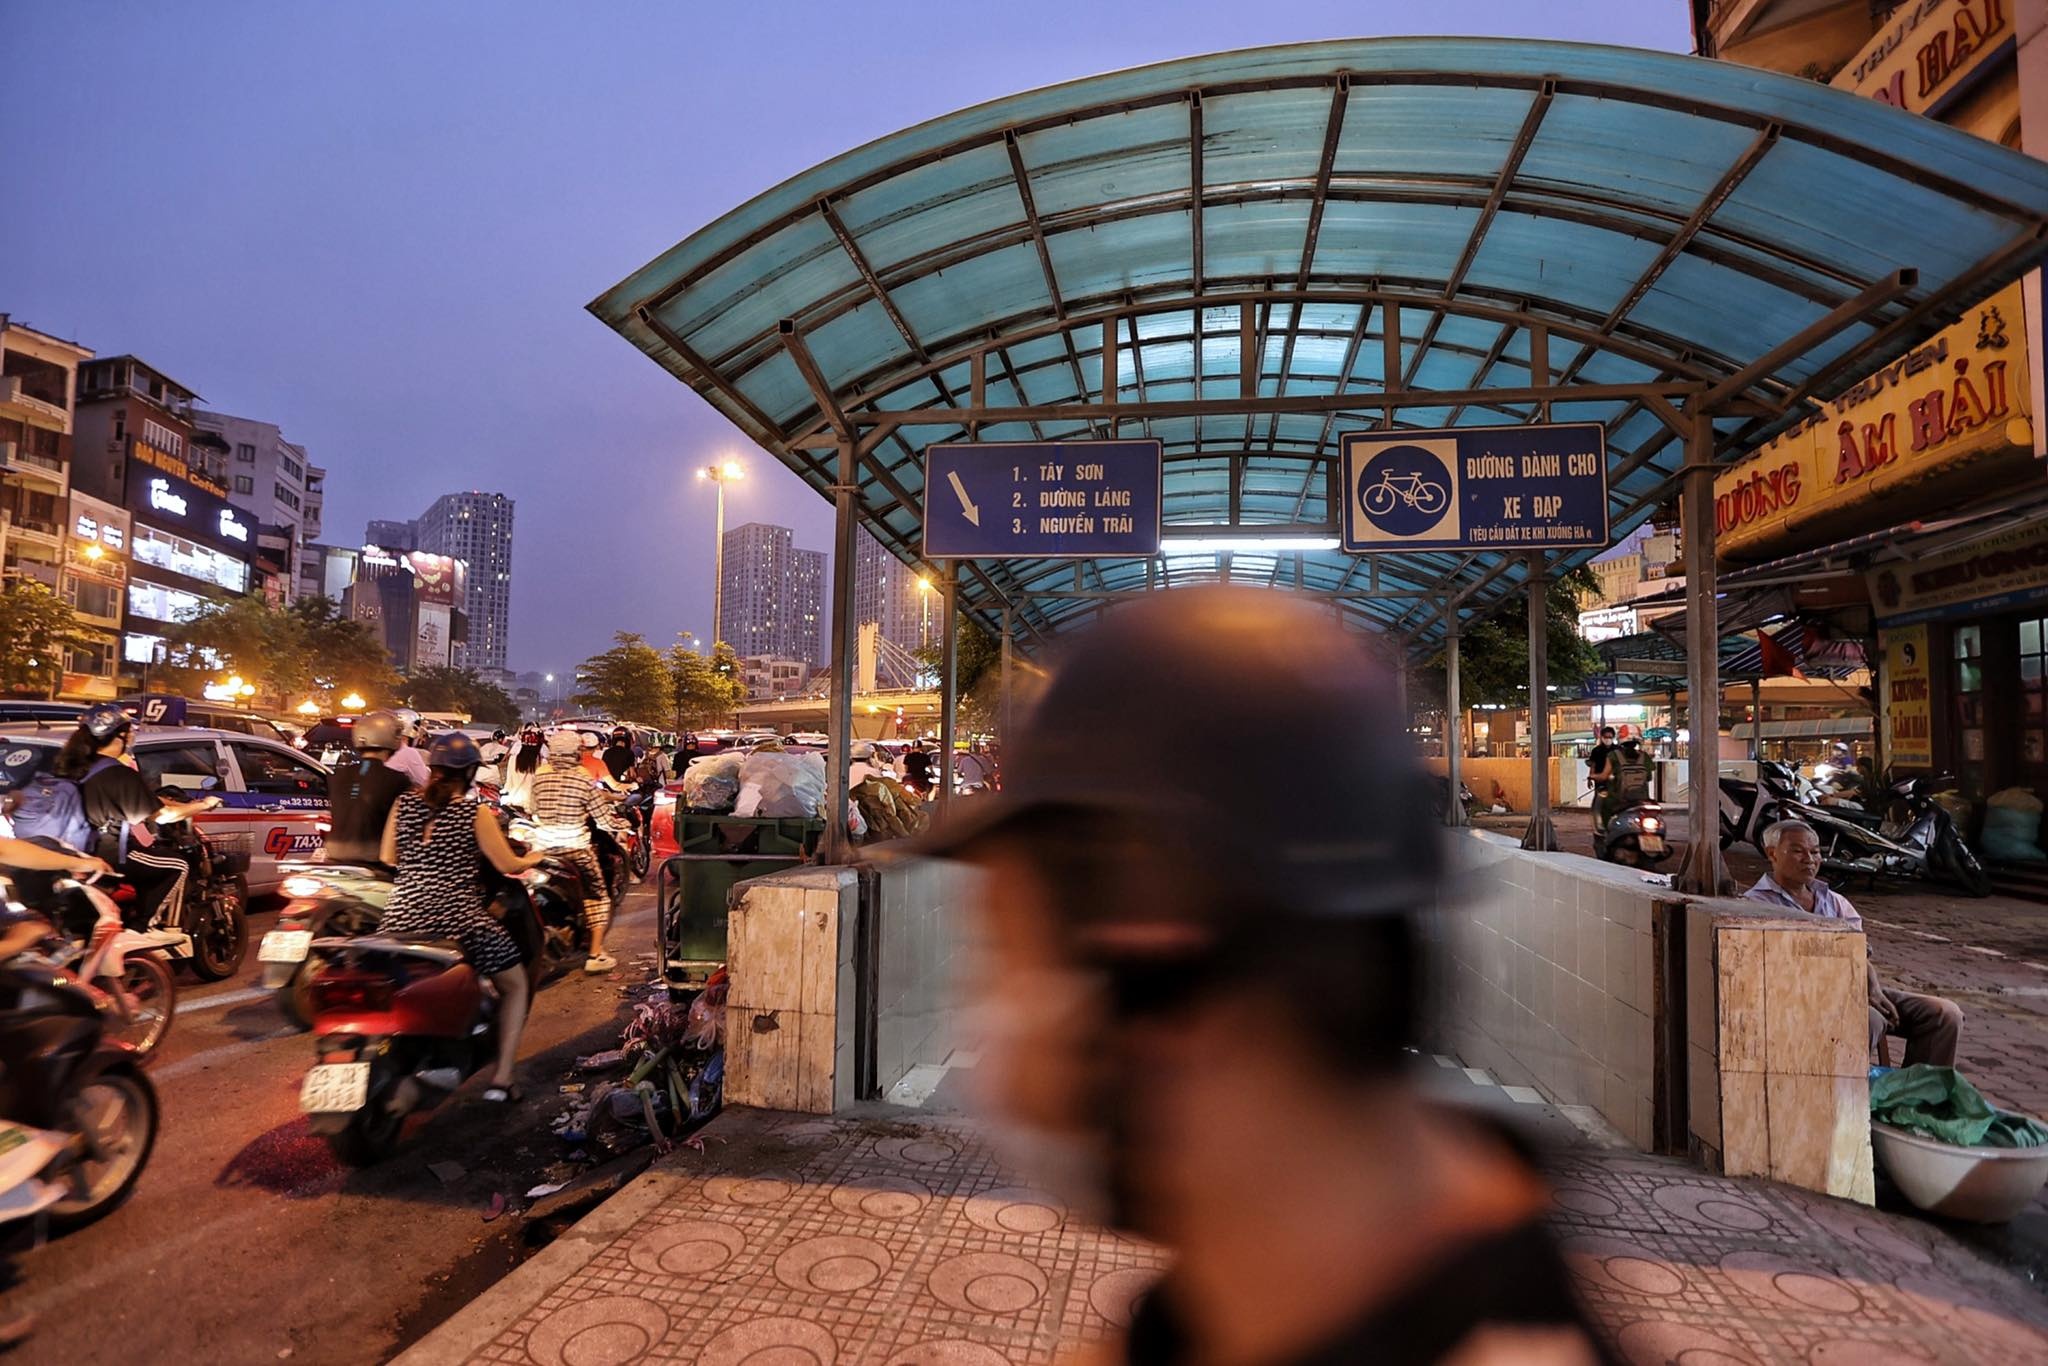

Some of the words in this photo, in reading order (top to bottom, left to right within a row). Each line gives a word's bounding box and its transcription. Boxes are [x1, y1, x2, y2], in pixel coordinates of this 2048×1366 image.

[1908, 357, 2009, 452] HẢI
[1012, 466, 1028, 482] 1.
[1040, 462, 1064, 481] TÂY
[1075, 463, 1104, 480] SƠN
[1466, 451, 1515, 480] ĐƯỜNG
[1521, 450, 1561, 478] DÀNH
[1567, 453, 1597, 476] CHO
[1012, 492, 1028, 508] 2.
[1040, 487, 1086, 508] ĐƯỜNG
[1094, 486, 1131, 507] LÁNG
[1503, 497, 1522, 519] XE
[1533, 495, 1562, 523] ĐẠP
[1012, 518, 1027, 534] 3.
[1040, 511, 1094, 534] NGUYỄN
[1102, 513, 1133, 533] TRÃI
[1521, 527, 1531, 540] XE
[1532, 526, 1546, 540] KHI
[146, 699, 168, 721] G7
